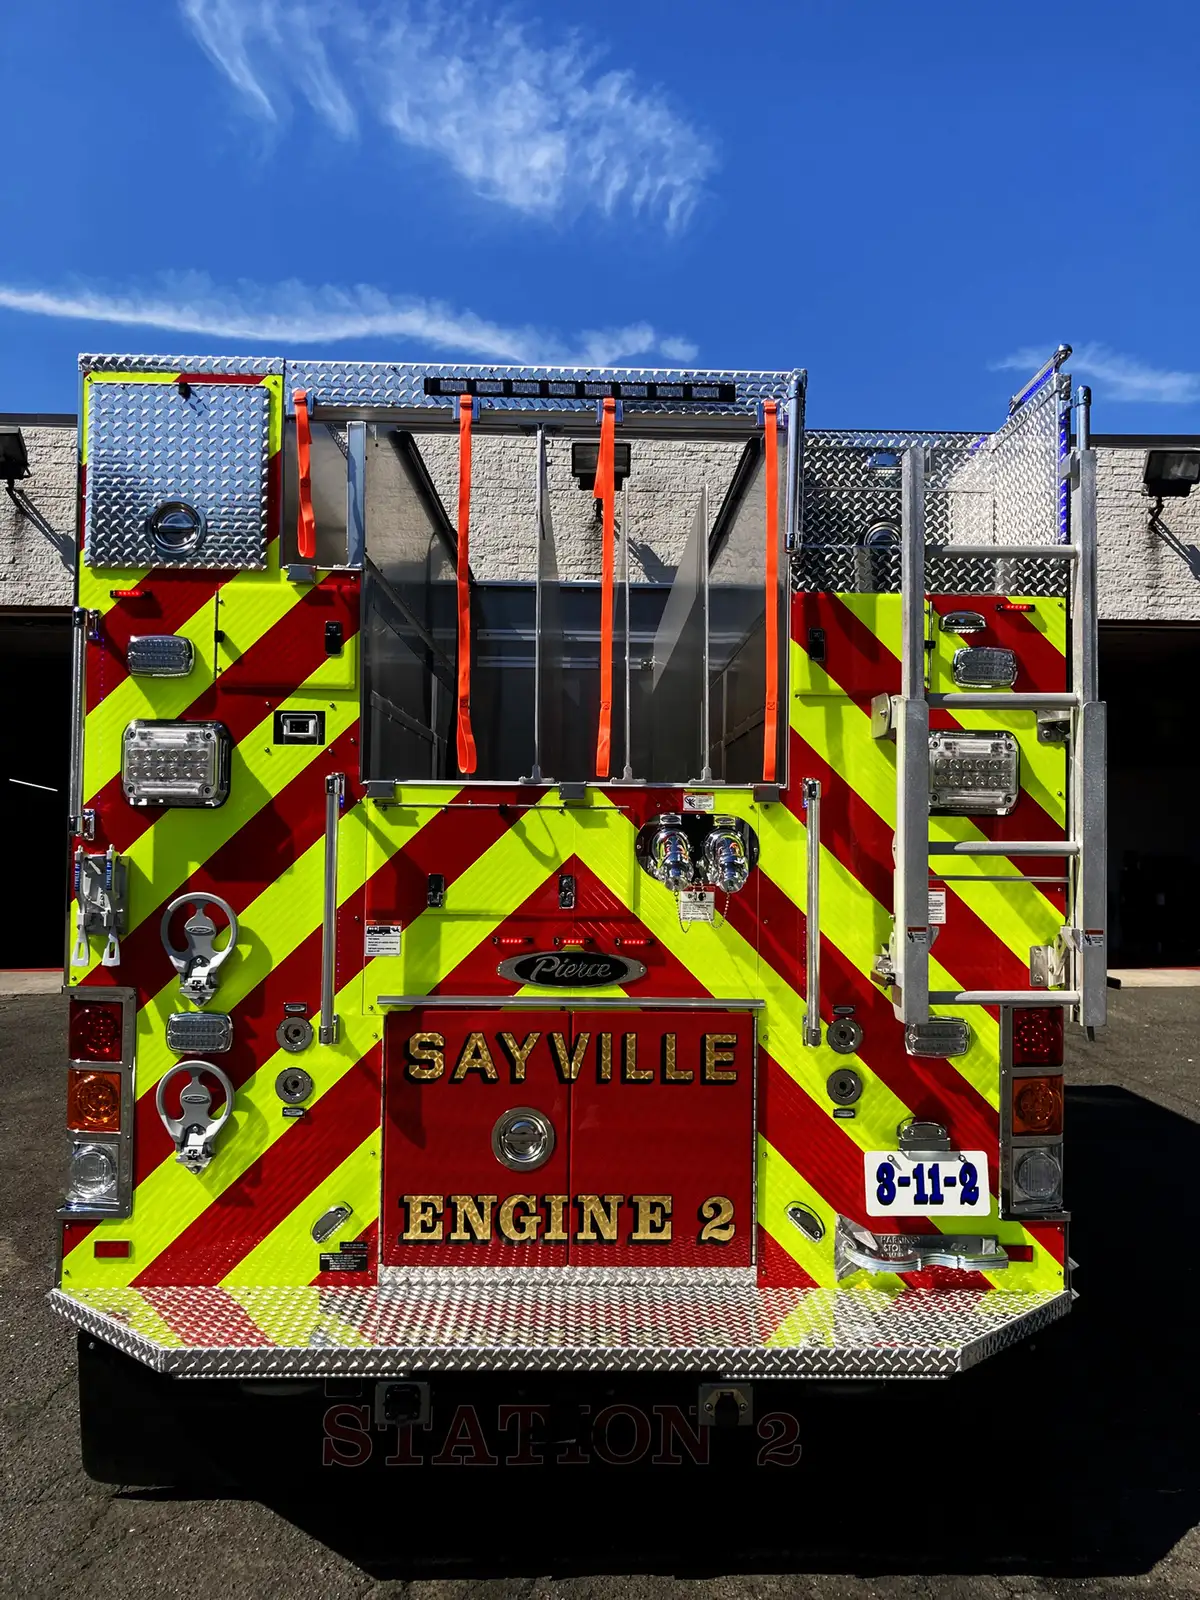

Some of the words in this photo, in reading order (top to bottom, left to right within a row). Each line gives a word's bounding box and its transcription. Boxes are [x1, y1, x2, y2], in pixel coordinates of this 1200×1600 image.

[530, 956, 612, 982] Pierce
[405, 1032, 738, 1083] SAYVILLE
[399, 1194, 673, 1243] ENGINE
[698, 1195, 736, 1243] 2
[756, 1411, 803, 1467] 2
